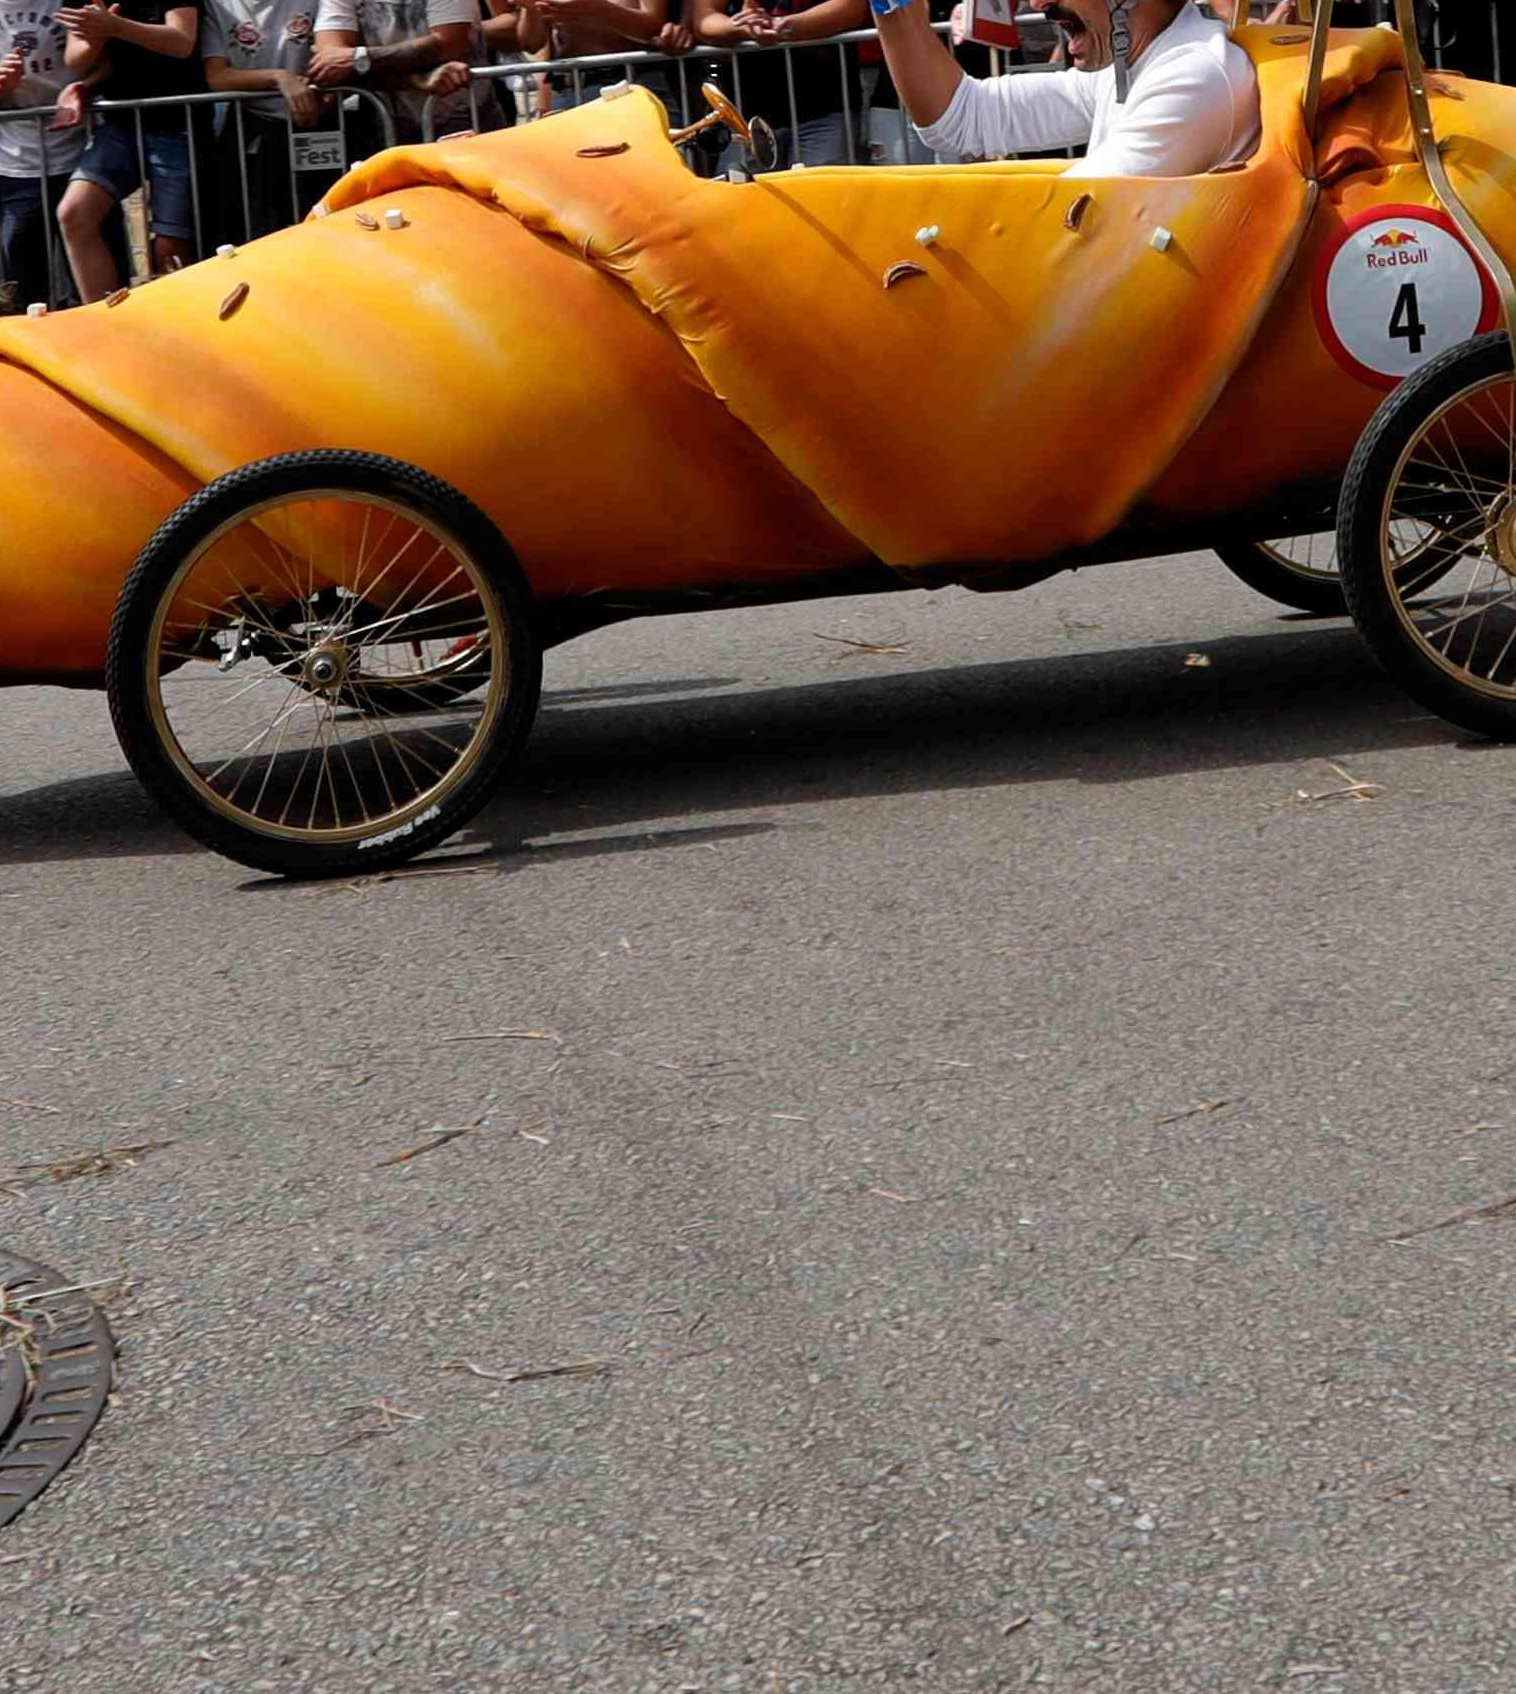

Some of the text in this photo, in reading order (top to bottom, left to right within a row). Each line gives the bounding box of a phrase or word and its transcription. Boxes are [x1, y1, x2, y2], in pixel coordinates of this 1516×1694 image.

[295, 147, 341, 166] Fest
[1366, 247, 1428, 269] Red Bull
[1387, 282, 1426, 354] 4
